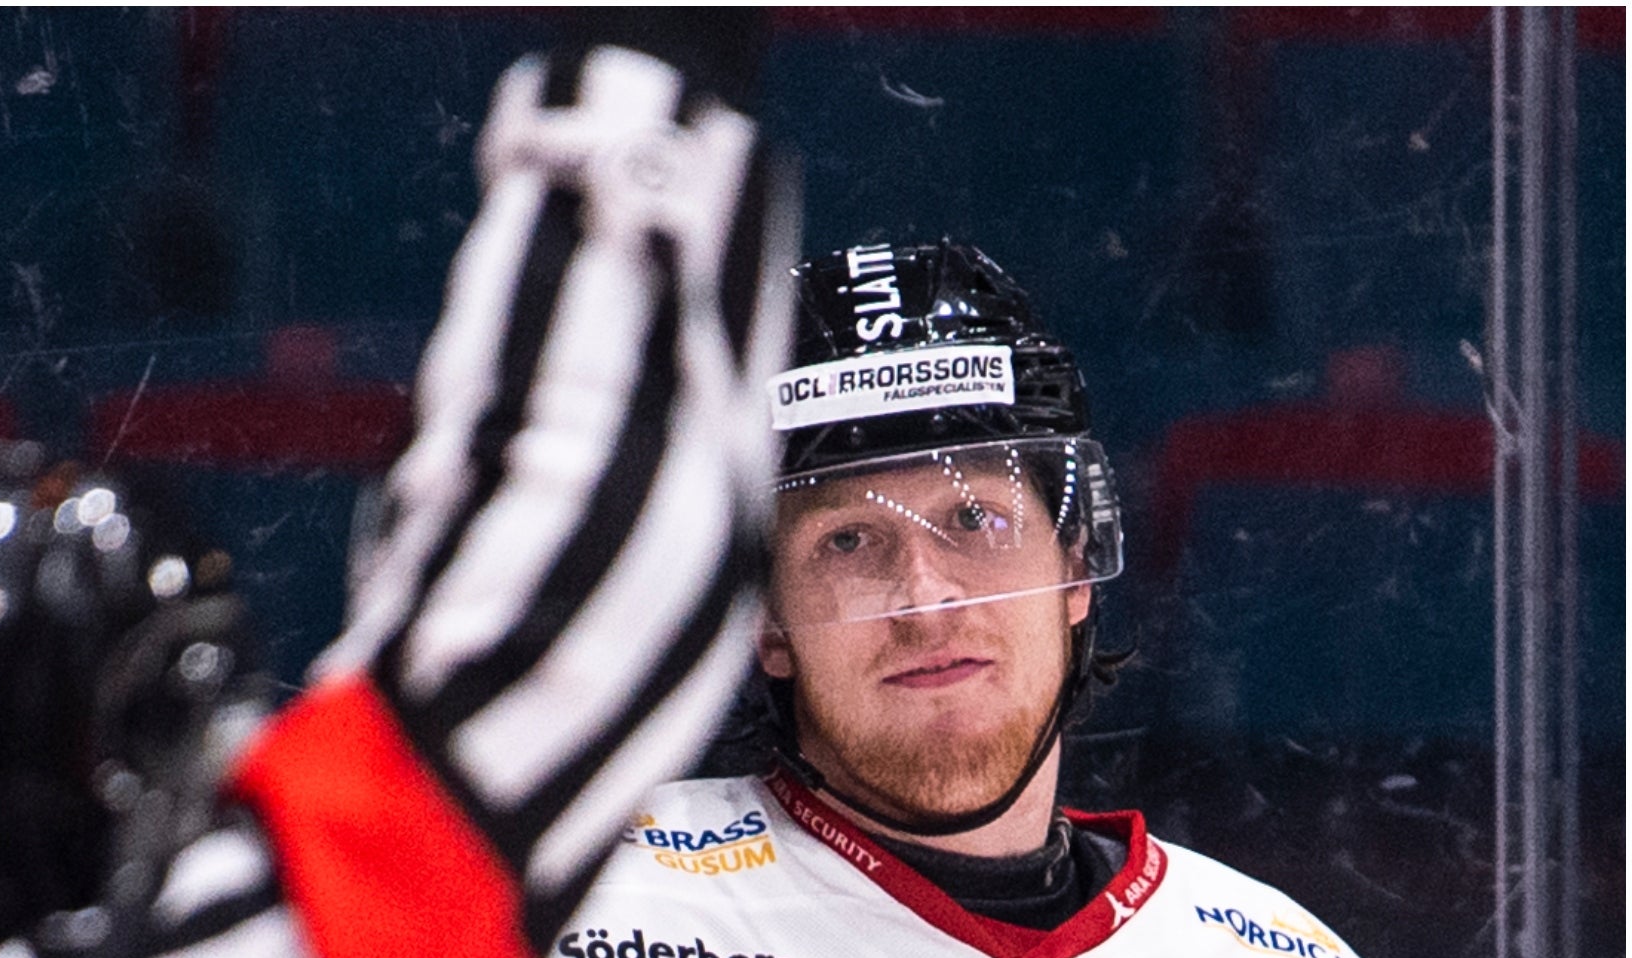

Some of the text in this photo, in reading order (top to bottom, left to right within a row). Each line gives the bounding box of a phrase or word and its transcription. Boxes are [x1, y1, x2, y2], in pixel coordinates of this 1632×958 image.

[644, 810, 767, 853] BRASS
[793, 800, 883, 872] SECURITY
[654, 841, 777, 876] GUSUM
